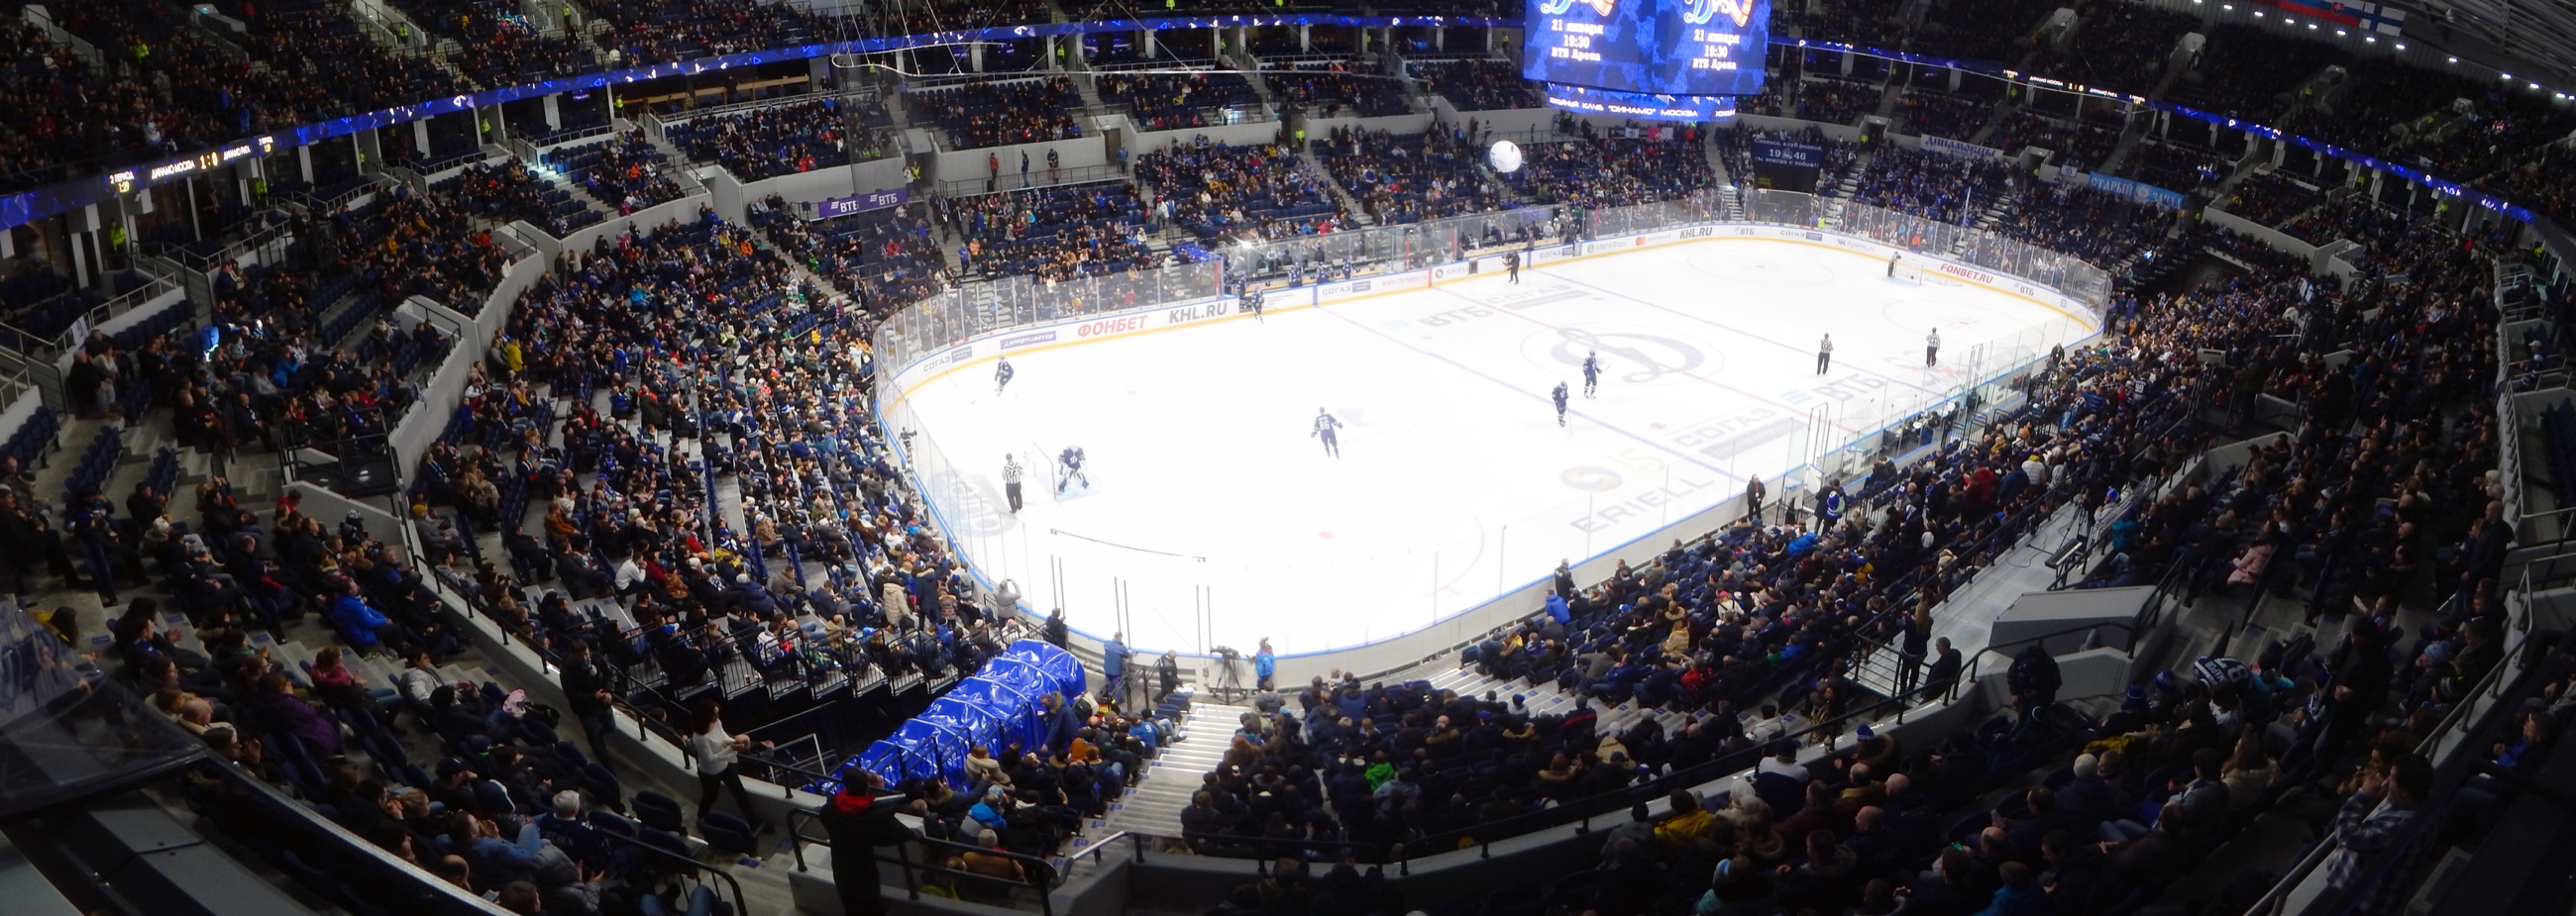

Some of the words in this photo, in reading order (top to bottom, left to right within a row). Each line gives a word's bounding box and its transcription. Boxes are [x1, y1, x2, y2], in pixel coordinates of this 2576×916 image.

[1552, 19, 1562, 31] 21
[1563, 35, 1590, 49] 19:30
[1693, 29, 1704, 42] 21
[1571, 49, 1601, 61] Арена
[1704, 45, 1728, 58] 19:30
[1711, 58, 1737, 70] Арена
[1582, 102, 1604, 111] КЛУБ
[1769, 149, 1781, 157] 19
[1793, 152, 1806, 160] 46
[174, 159, 196, 173] МОСКВА
[2091, 174, 2133, 196] СТАРЫЙ
[878, 193, 898, 206] ВТБ
[1680, 227, 1713, 239] KHL.RU
[1940, 263, 1994, 284] FONBET.RU
[1322, 285, 1351, 296] СОГАЗ
[2019, 285, 2034, 296] ВТБ
[1168, 302, 1229, 324] KHL.RU
[1417, 306, 1495, 328] ВТБ
[1077, 315, 1149, 338] ФОНБЕТ
[923, 356, 951, 372] СОГАЗ
[1811, 373, 1887, 401] ВТБ
[1672, 408, 1778, 449] СОГАЗ
[1569, 476, 1716, 535] ERIELL
